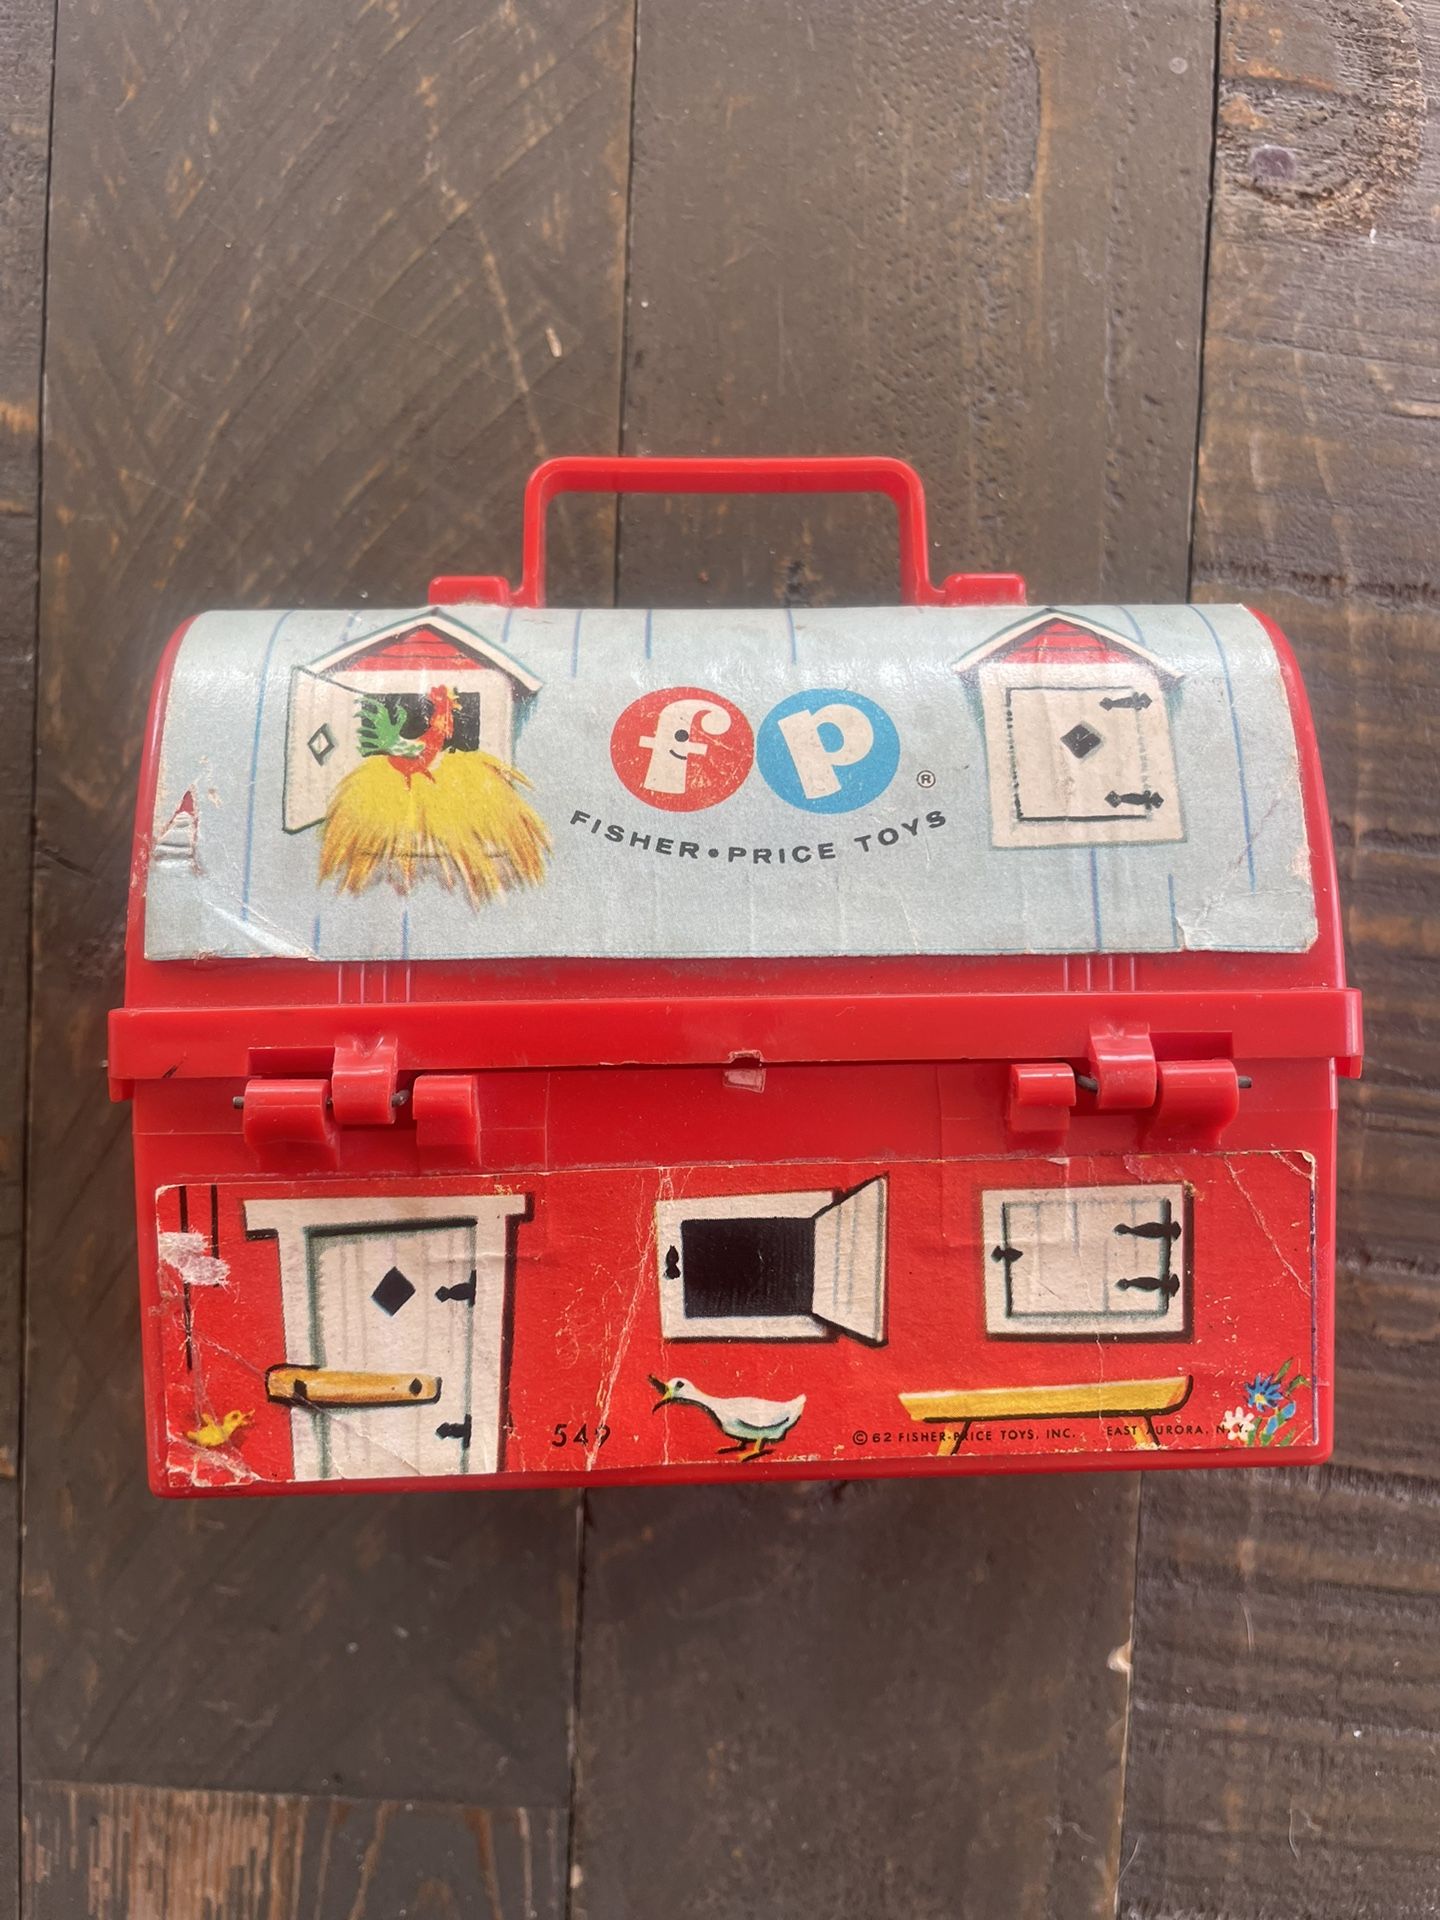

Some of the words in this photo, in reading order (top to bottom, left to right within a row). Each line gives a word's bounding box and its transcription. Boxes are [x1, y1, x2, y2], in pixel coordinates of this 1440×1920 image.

[854, 810, 947, 852] TOYS
[1046, 1427, 1076, 1439] INC.
[1106, 1425, 1137, 1436] EAST
